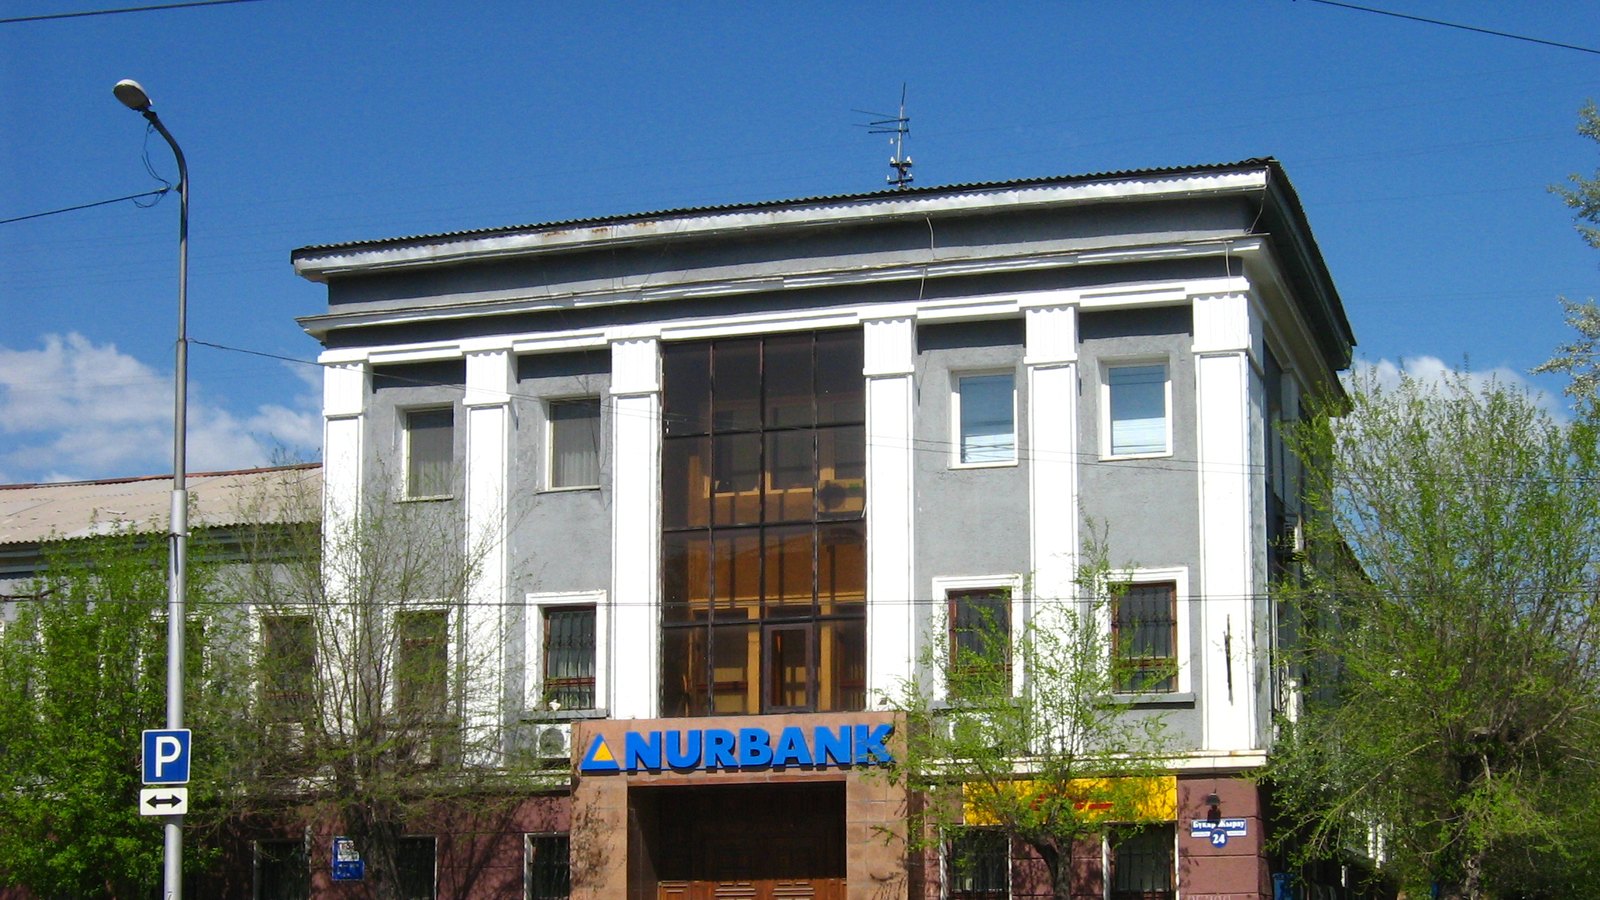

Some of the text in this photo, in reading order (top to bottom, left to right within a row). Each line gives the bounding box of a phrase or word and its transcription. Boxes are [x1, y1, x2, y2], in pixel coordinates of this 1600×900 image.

[155, 736, 181, 777] P
[625, 724, 896, 771] NURBANK
[1212, 833, 1226, 844] 24
